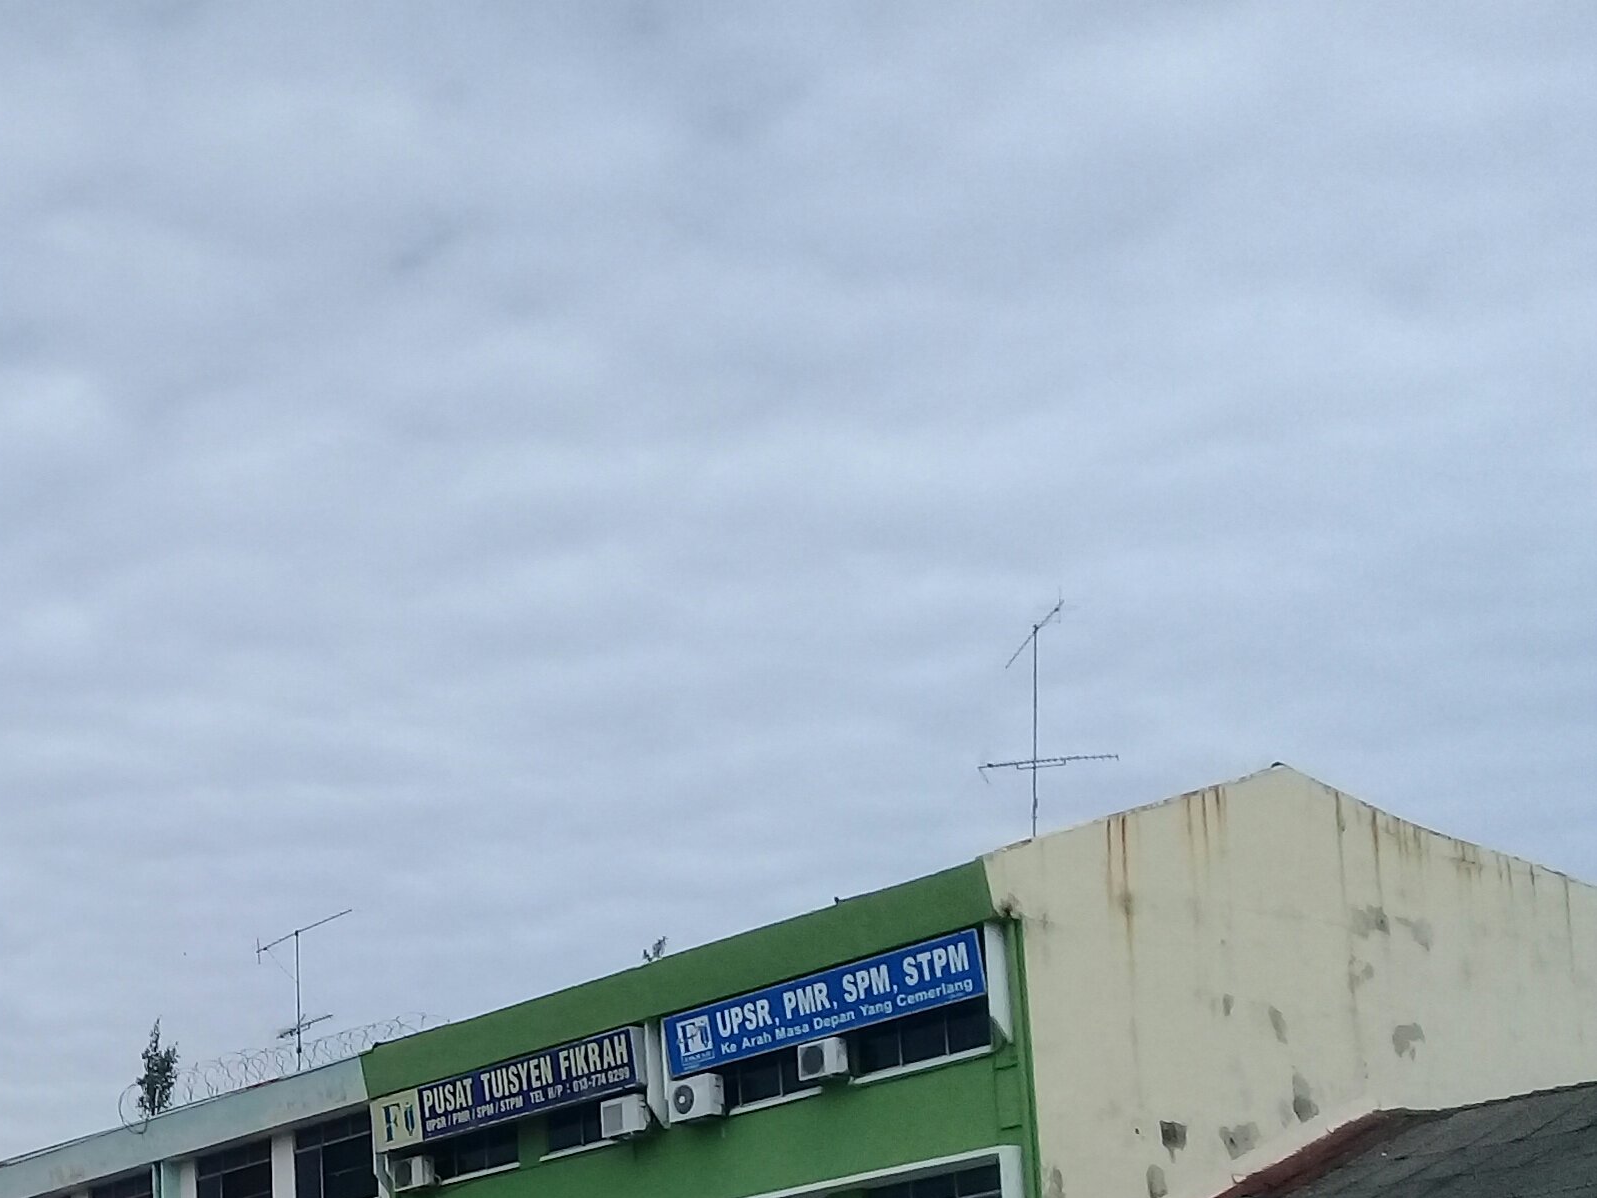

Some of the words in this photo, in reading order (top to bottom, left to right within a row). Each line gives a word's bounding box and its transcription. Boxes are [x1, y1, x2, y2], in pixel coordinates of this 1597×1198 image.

[716, 999, 780, 1037] UPSR,
[783, 982, 838, 1019] PMR,
[842, 964, 898, 1002] SPM,
[903, 942, 969, 986] STPM
[721, 1042, 737, 1055] Ke
[742, 1032, 772, 1049] Arah
[775, 1023, 809, 1040] Masa
[813, 1011, 855, 1030] Depan
[859, 1000, 893, 1016] Yang
[897, 979, 973, 1006] Cemerlang
[422, 1079, 473, 1118] PUSAT
[480, 1055, 553, 1100] TUISYEN
[559, 1034, 629, 1080] FIKRAH
[477, 1103, 494, 1118] SPM
[500, 1095, 523, 1112] STPM
